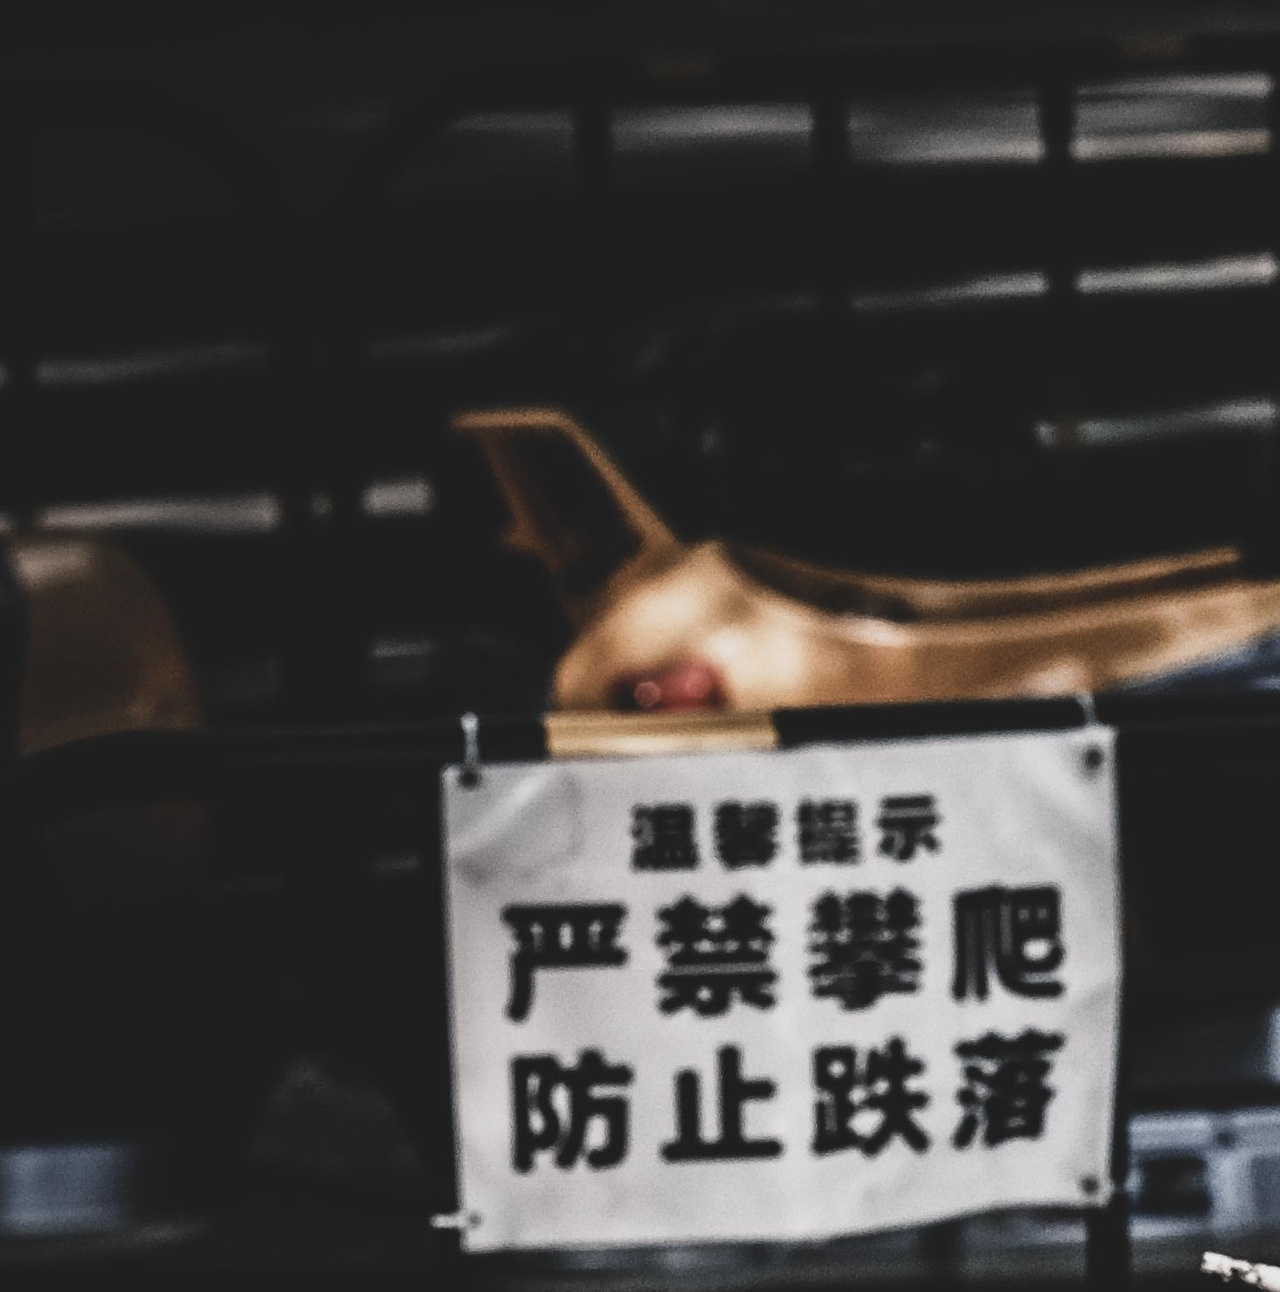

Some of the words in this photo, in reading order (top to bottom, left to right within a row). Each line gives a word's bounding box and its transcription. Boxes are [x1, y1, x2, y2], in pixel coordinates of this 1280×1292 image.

[631, 795, 938, 871] 温馨提示
[500, 885, 1065, 1022] 严禁攀爬
[510, 1029, 1065, 1174] 防止跌落
